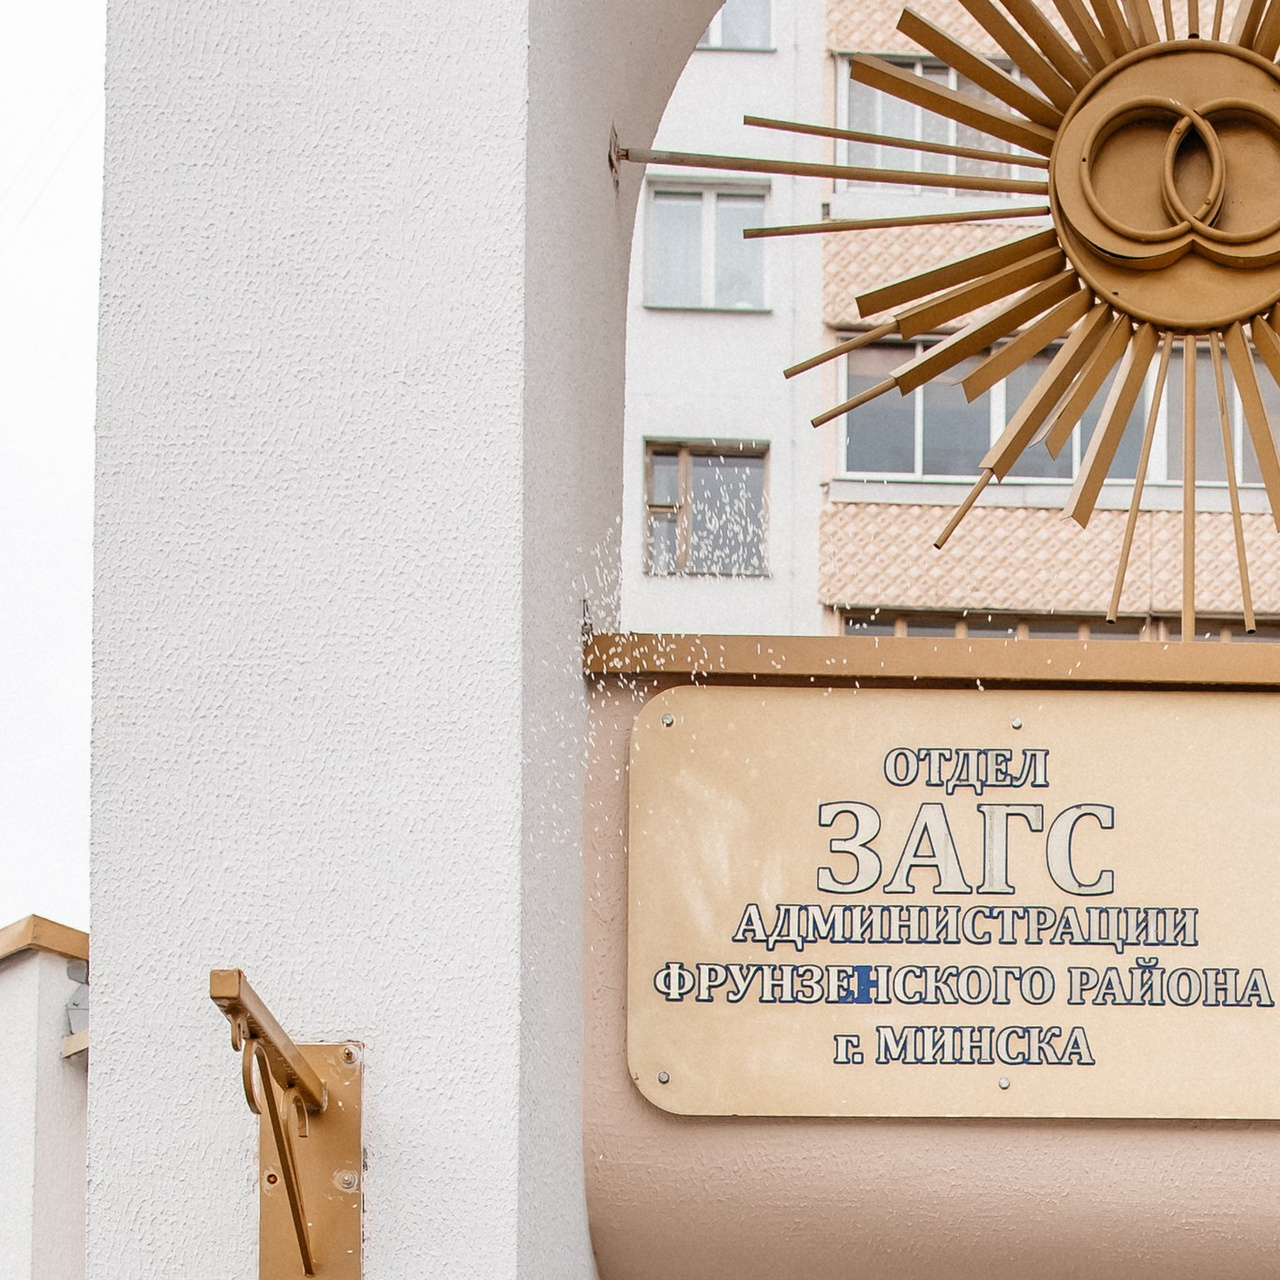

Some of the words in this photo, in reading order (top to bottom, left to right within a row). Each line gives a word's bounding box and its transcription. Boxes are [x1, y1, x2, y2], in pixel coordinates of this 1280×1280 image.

[883, 747, 1050, 795] ОТДЕЛ
[815, 801, 1116, 897] ЗАГС
[731, 903, 1199, 954] АДМИНИСТРАЦИИ
[653, 962, 1056, 1006] ФРУНЗЕНСКОГО
[1067, 957, 1275, 1008] РАЙОНА
[833, 1034, 865, 1065] г.
[874, 1025, 1096, 1066] МИНСКА
